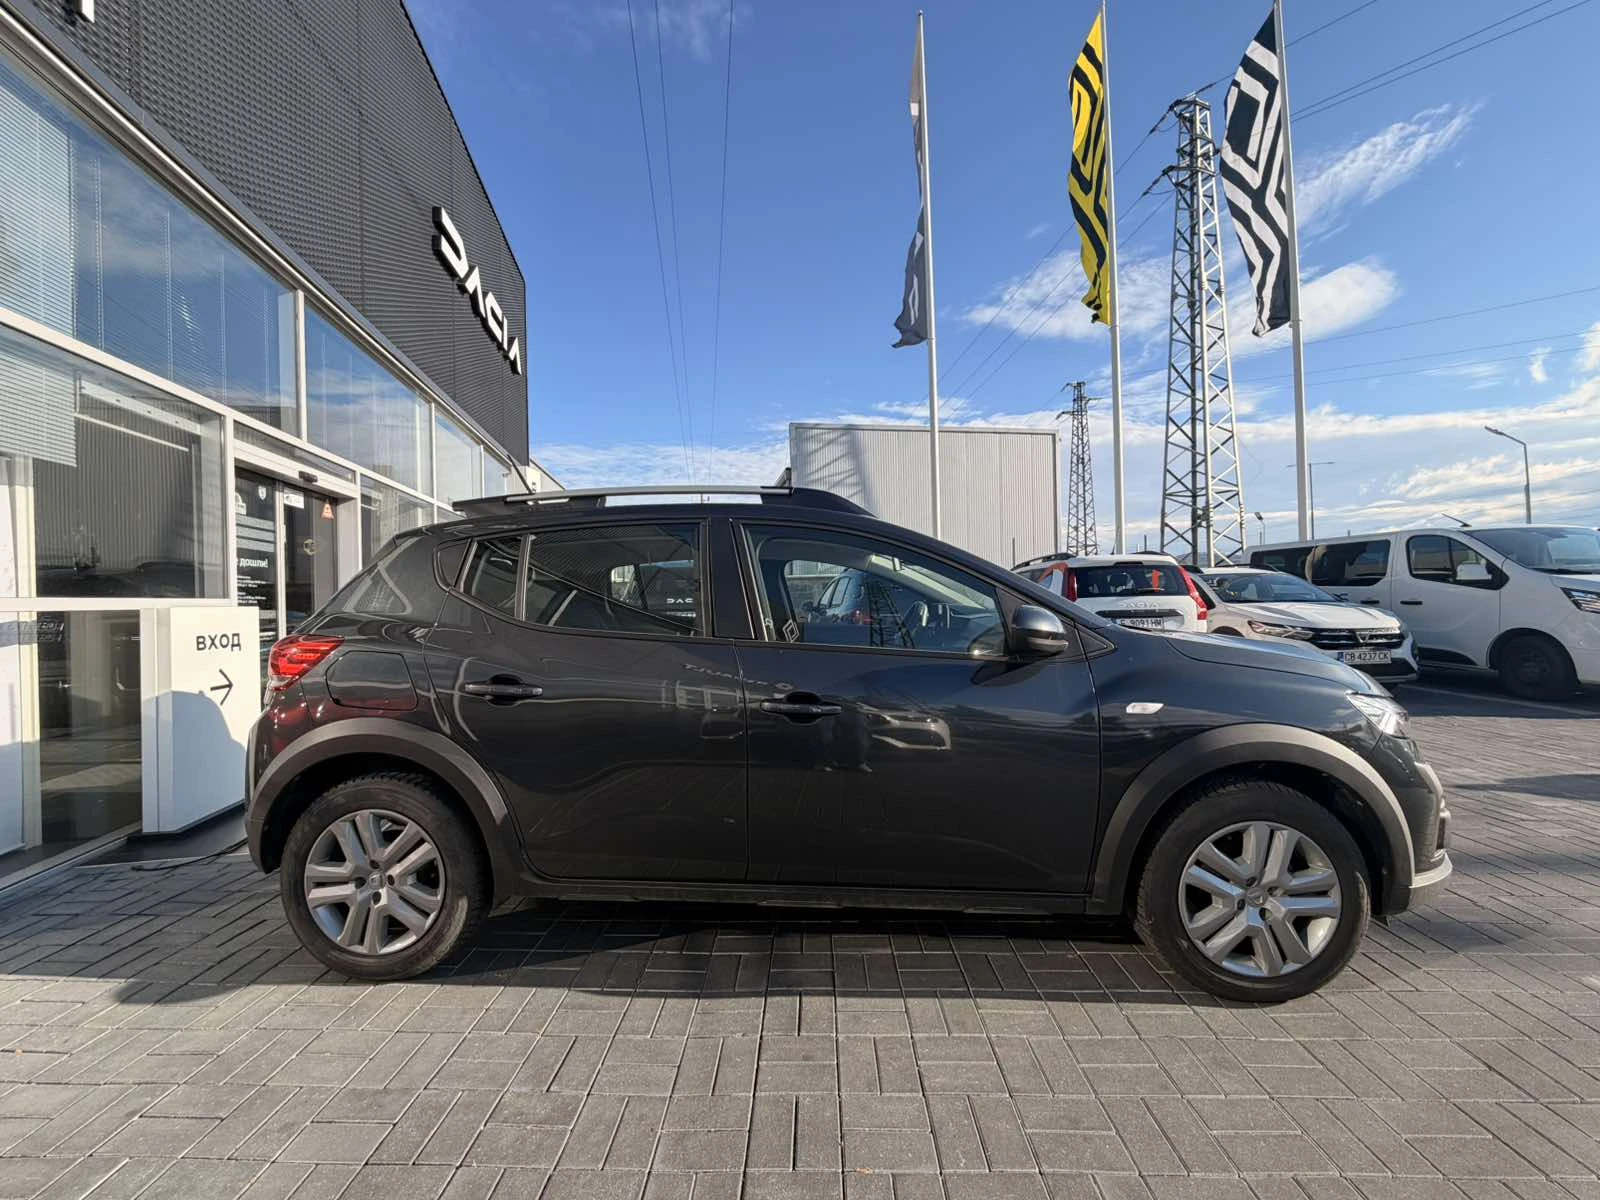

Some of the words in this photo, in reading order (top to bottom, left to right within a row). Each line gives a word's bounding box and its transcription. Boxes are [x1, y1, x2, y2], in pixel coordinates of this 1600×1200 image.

[436, 206, 522, 376] DACIA
[240, 558, 269, 568] дошли!
[196, 633, 241, 652] ВХОД
